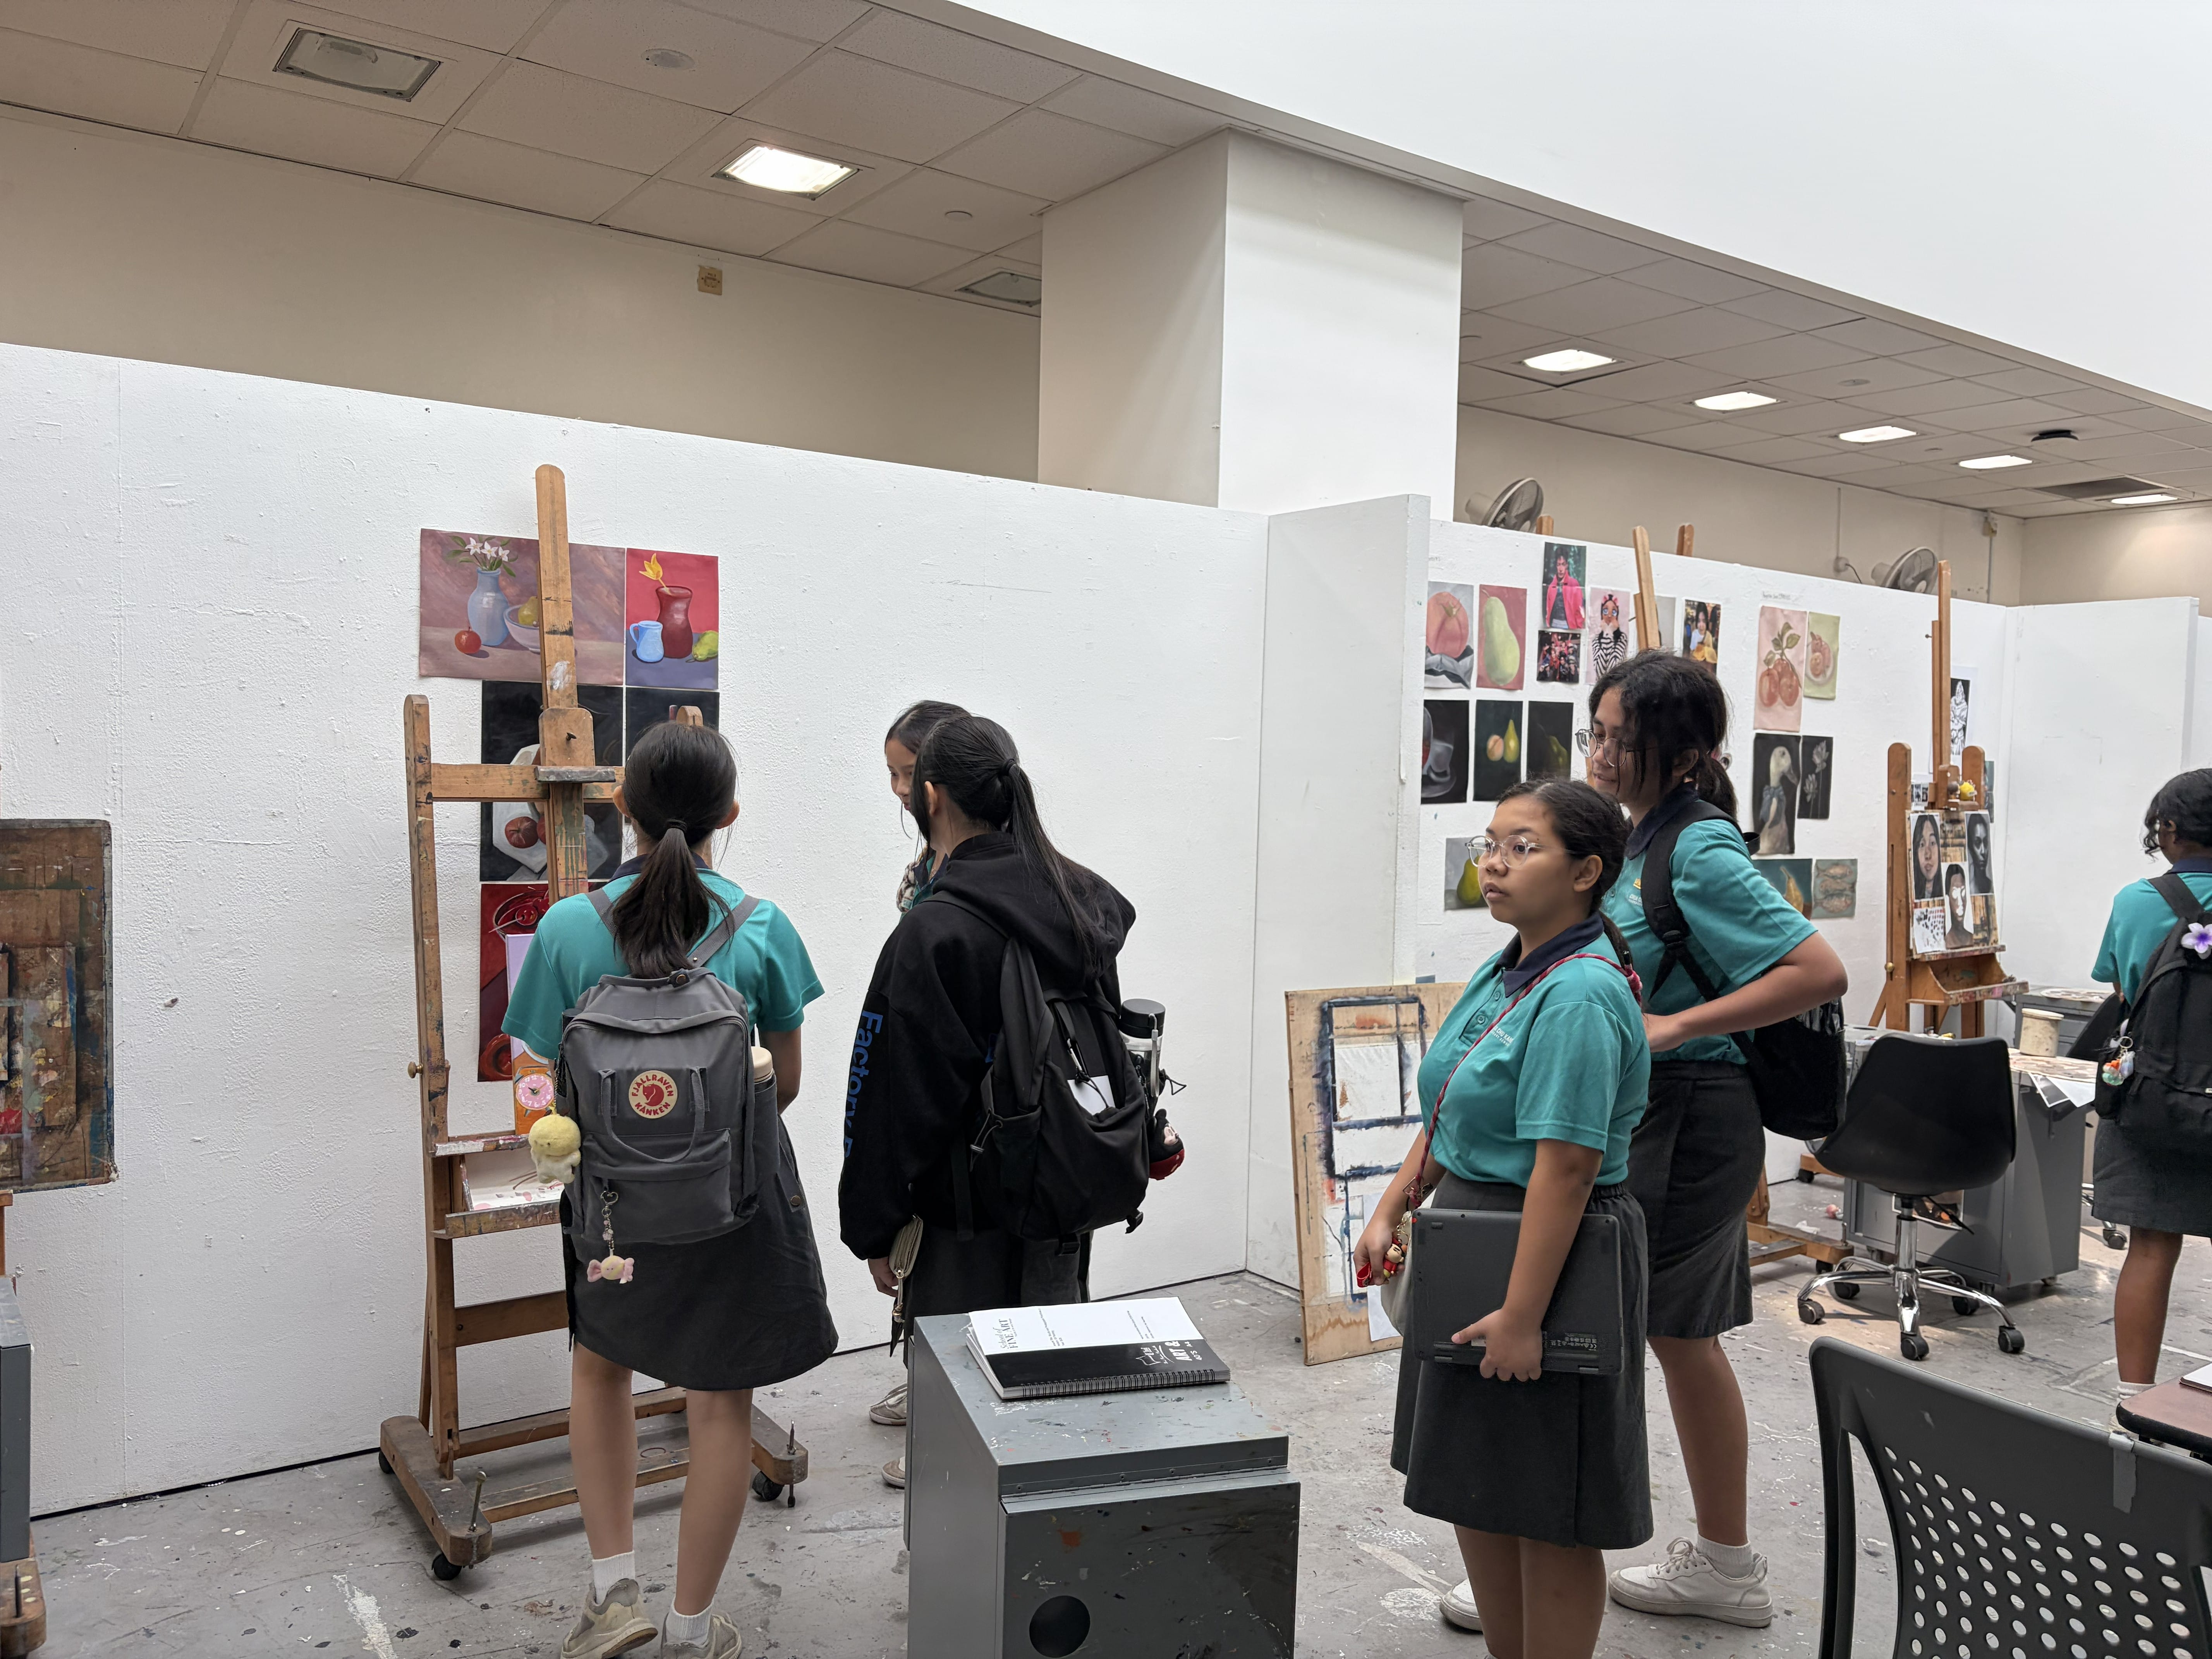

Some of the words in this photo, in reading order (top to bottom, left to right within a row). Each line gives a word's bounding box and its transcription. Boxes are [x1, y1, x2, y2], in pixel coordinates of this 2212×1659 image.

[999, 1319, 1011, 1333] ART
[995, 1334, 1009, 1349] School
[1005, 1334, 1018, 1348] FINE
[1169, 1348, 1193, 1361] ART
